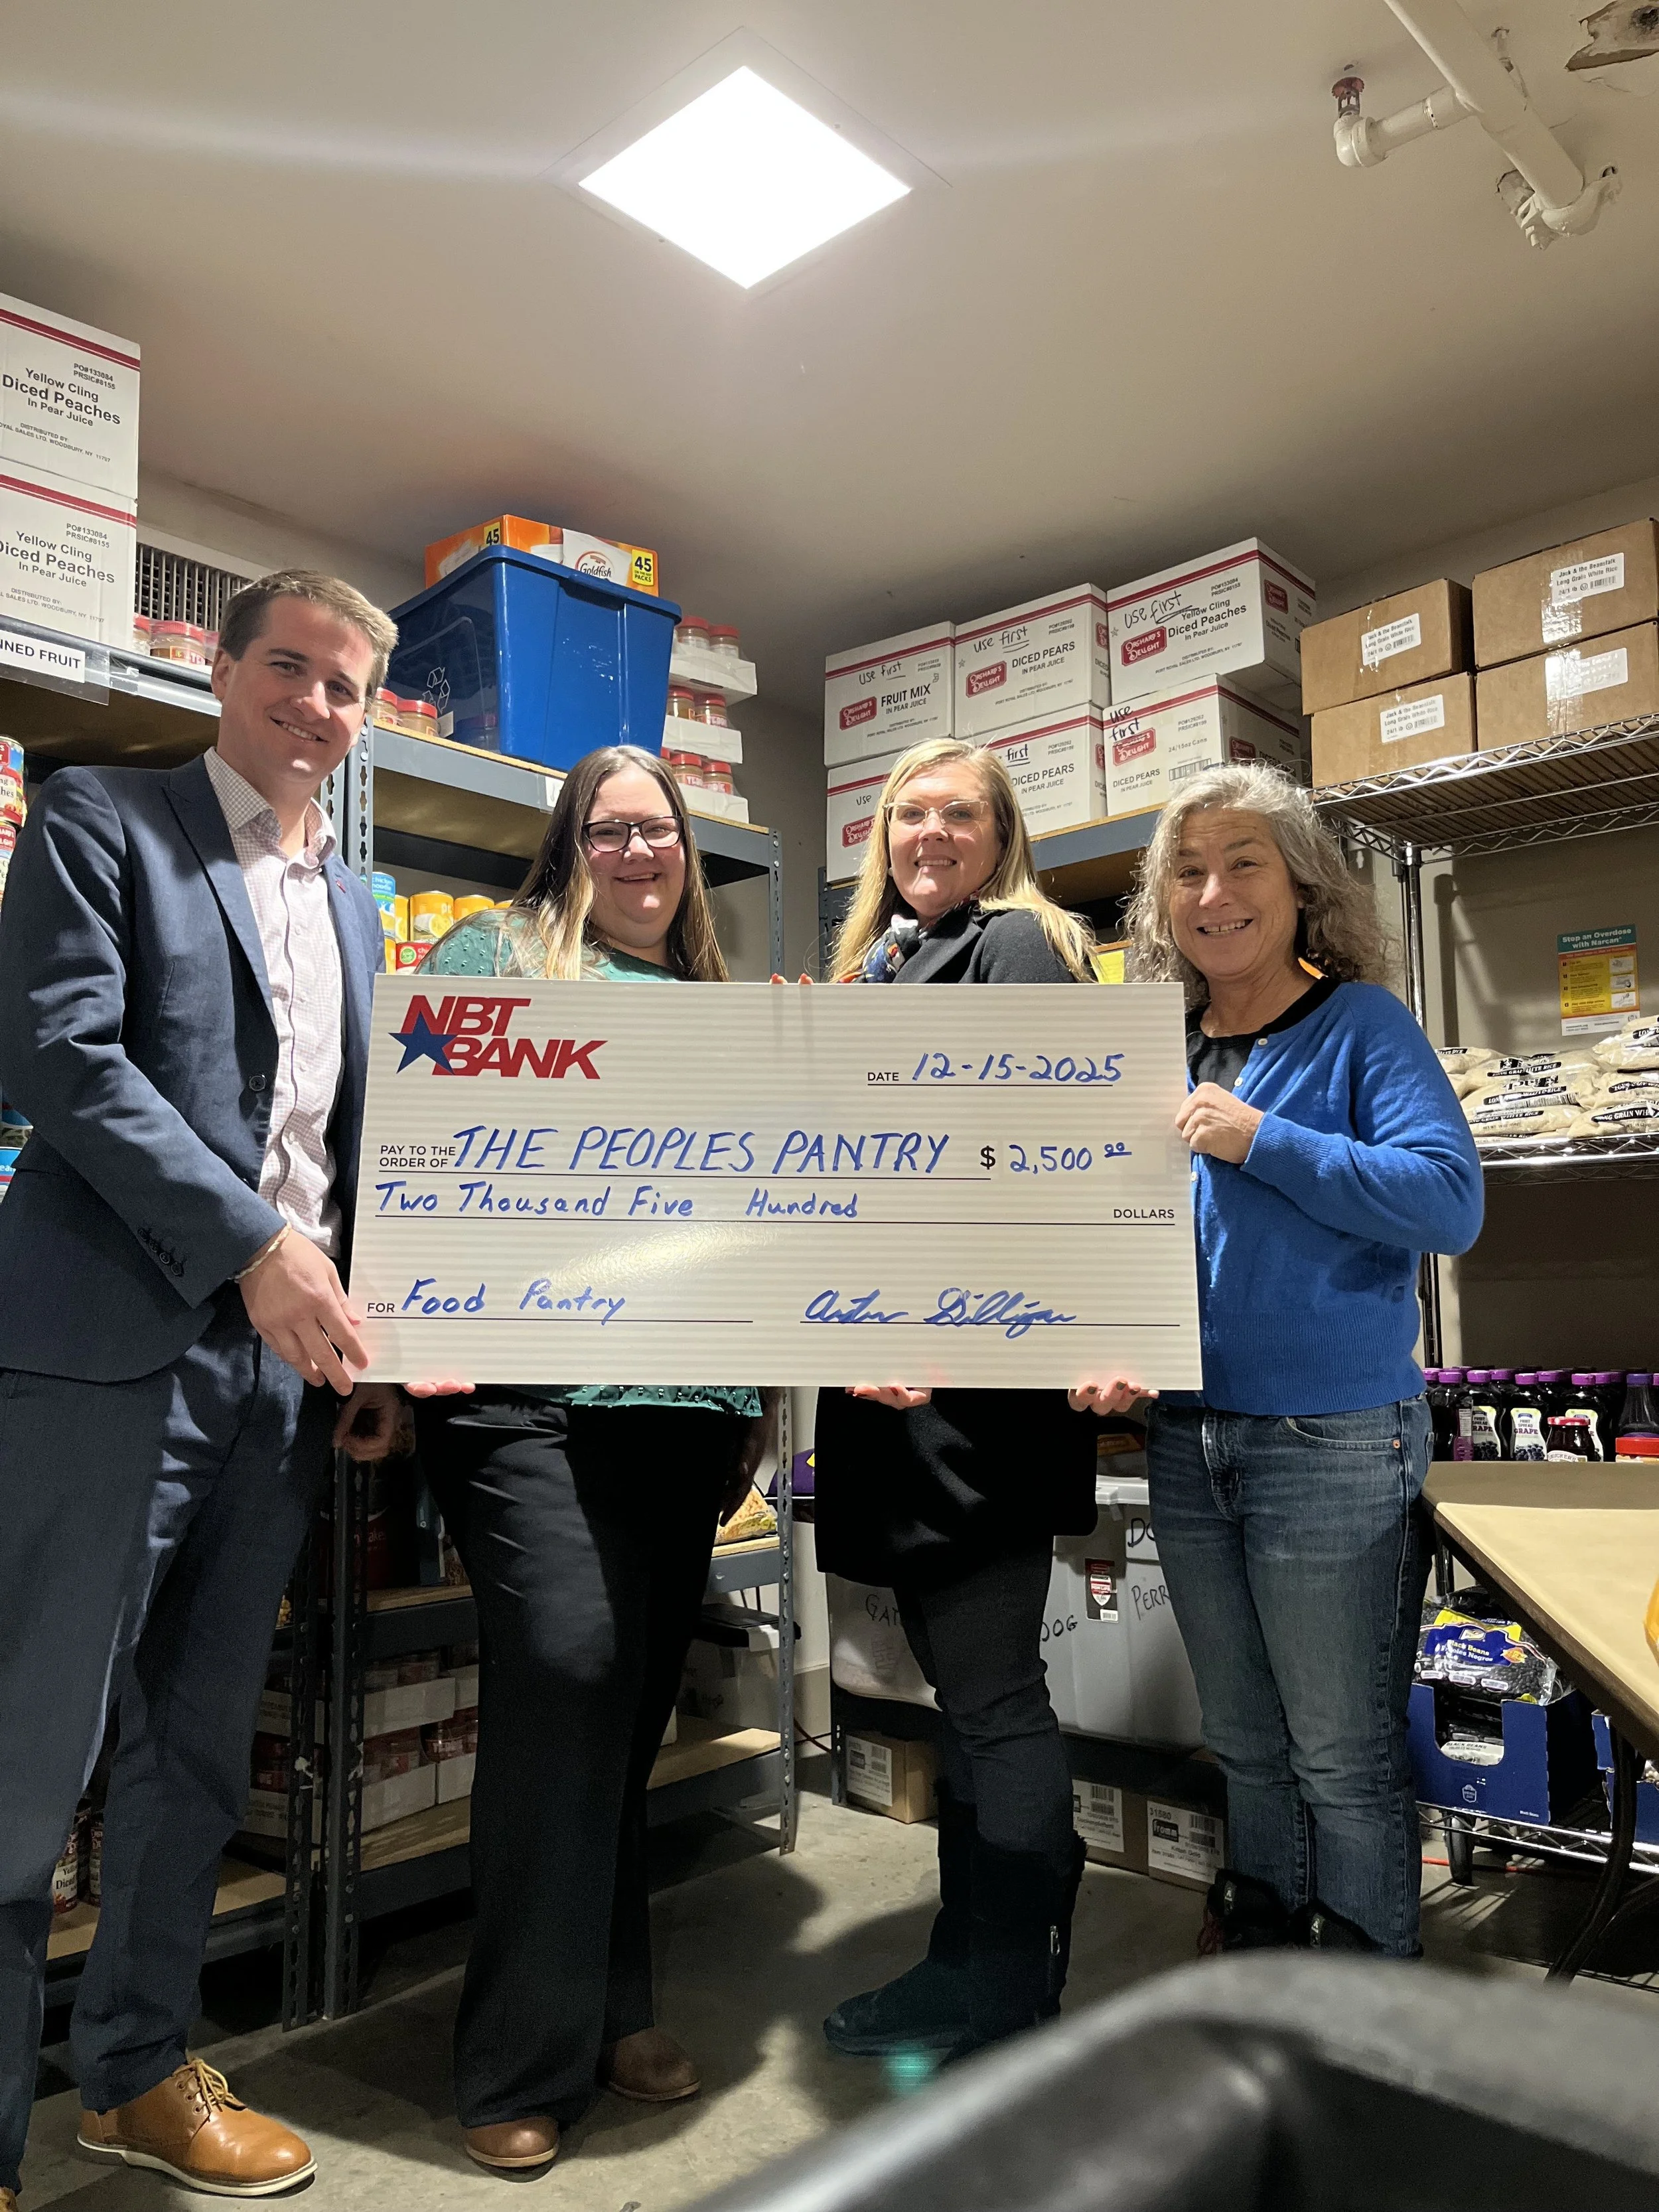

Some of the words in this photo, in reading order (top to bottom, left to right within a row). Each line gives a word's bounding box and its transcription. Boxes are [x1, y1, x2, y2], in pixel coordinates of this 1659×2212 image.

[25, 368, 64, 389] Yellow
[68, 383, 99, 403] Cling
[2, 374, 48, 400] Diced
[54, 391, 121, 425] Peaches
[28, 398, 37, 408] In
[40, 402, 64, 416] Pear
[66, 411, 94, 427] Juice
[15, 427, 34, 438] SALES
[20, 423, 59, 439] DISTRIBUTED
[66, 523, 108, 540] PO#133084
[66, 531, 110, 548] PRSIC#8155
[486, 528, 500, 546] 45
[16, 530, 56, 550] Yellow
[61, 544, 92, 563] Cling
[46, 553, 115, 583] Peaches
[580, 563, 612, 577] Goldfish
[634, 556, 652, 573] 45
[1589, 558, 1616, 569] Beanstalk
[19, 561, 29, 571] In
[32, 565, 56, 579] Pear
[58, 573, 87, 587] Juice
[634, 574, 652, 583] PACKS
[5, 593, 26, 603] SALES
[11, 587, 50, 603] DISTRIBUTED
[1150, 590, 1181, 625] first
[1181, 607, 1206, 621] Yellow
[1209, 599, 1230, 611] Cling
[1168, 621, 1197, 638] Diced
[1201, 605, 1247, 627] Peaches
[1193, 629, 1208, 639] Pear
[1210, 622, 1228, 632] Juice
[999, 626, 1028, 645] first
[39, 650, 81, 669] FRUIT
[1012, 652, 1041, 668] DICED
[1043, 641, 1075, 659] PEARS
[1127, 642, 1159, 661] DELIGHT
[1029, 663, 1045, 673] PEAR
[1046, 657, 1065, 668] JUICE
[972, 676, 1001, 694] DELIGHT
[881, 690, 907, 707] FRUIT
[910, 684, 931, 700] MIX
[894, 703, 908, 713] PEAR
[910, 698, 926, 708] JUICE
[1109, 717, 1139, 741] first
[1005, 743, 1029, 761] first
[1011, 772, 1040, 787] DICED
[1042, 763, 1074, 779] PEARS
[1113, 776, 1135, 788] DICED
[1135, 769, 1160, 781] PEARS
[1029, 783, 1045, 793] PEAR
[1046, 778, 1064, 788] JUICE
[1594, 928, 1632, 938] Overdose
[401, 995, 532, 1037] NBT
[431, 1036, 608, 1079] BANK
[867, 1072, 899, 1082] DATE
[912, 1052, 1125, 1083] 12-15-2025
[1614, 1110, 1634, 1120] GRAIN
[380, 1145, 405, 1156] PAY
[409, 1145, 429, 1156] TO
[431, 1146, 456, 1157] THE
[453, 1125, 559, 1171] THE
[569, 1126, 756, 1173] PEOPLES
[771, 1129, 950, 1175] PANTRY
[380, 1157, 426, 1168] ORDER
[430, 1158, 448, 1168] OF
[980, 1145, 996, 1170] $
[1009, 1144, 1092, 1175] 2,500
[376, 1181, 438, 1212] Two
[459, 1181, 611, 1217] Thousand
[628, 1185, 693, 1217] Five
[745, 1187, 858, 1218] Hundred
[1114, 1209, 1175, 1218] DOLLARS
[367, 1303, 395, 1313] FOR
[401, 1278, 486, 1315] Food
[519, 1278, 626, 1326] Pantry
[1467, 1645, 1490, 1656] Beans
[1469, 1652, 1493, 1661] Negros
